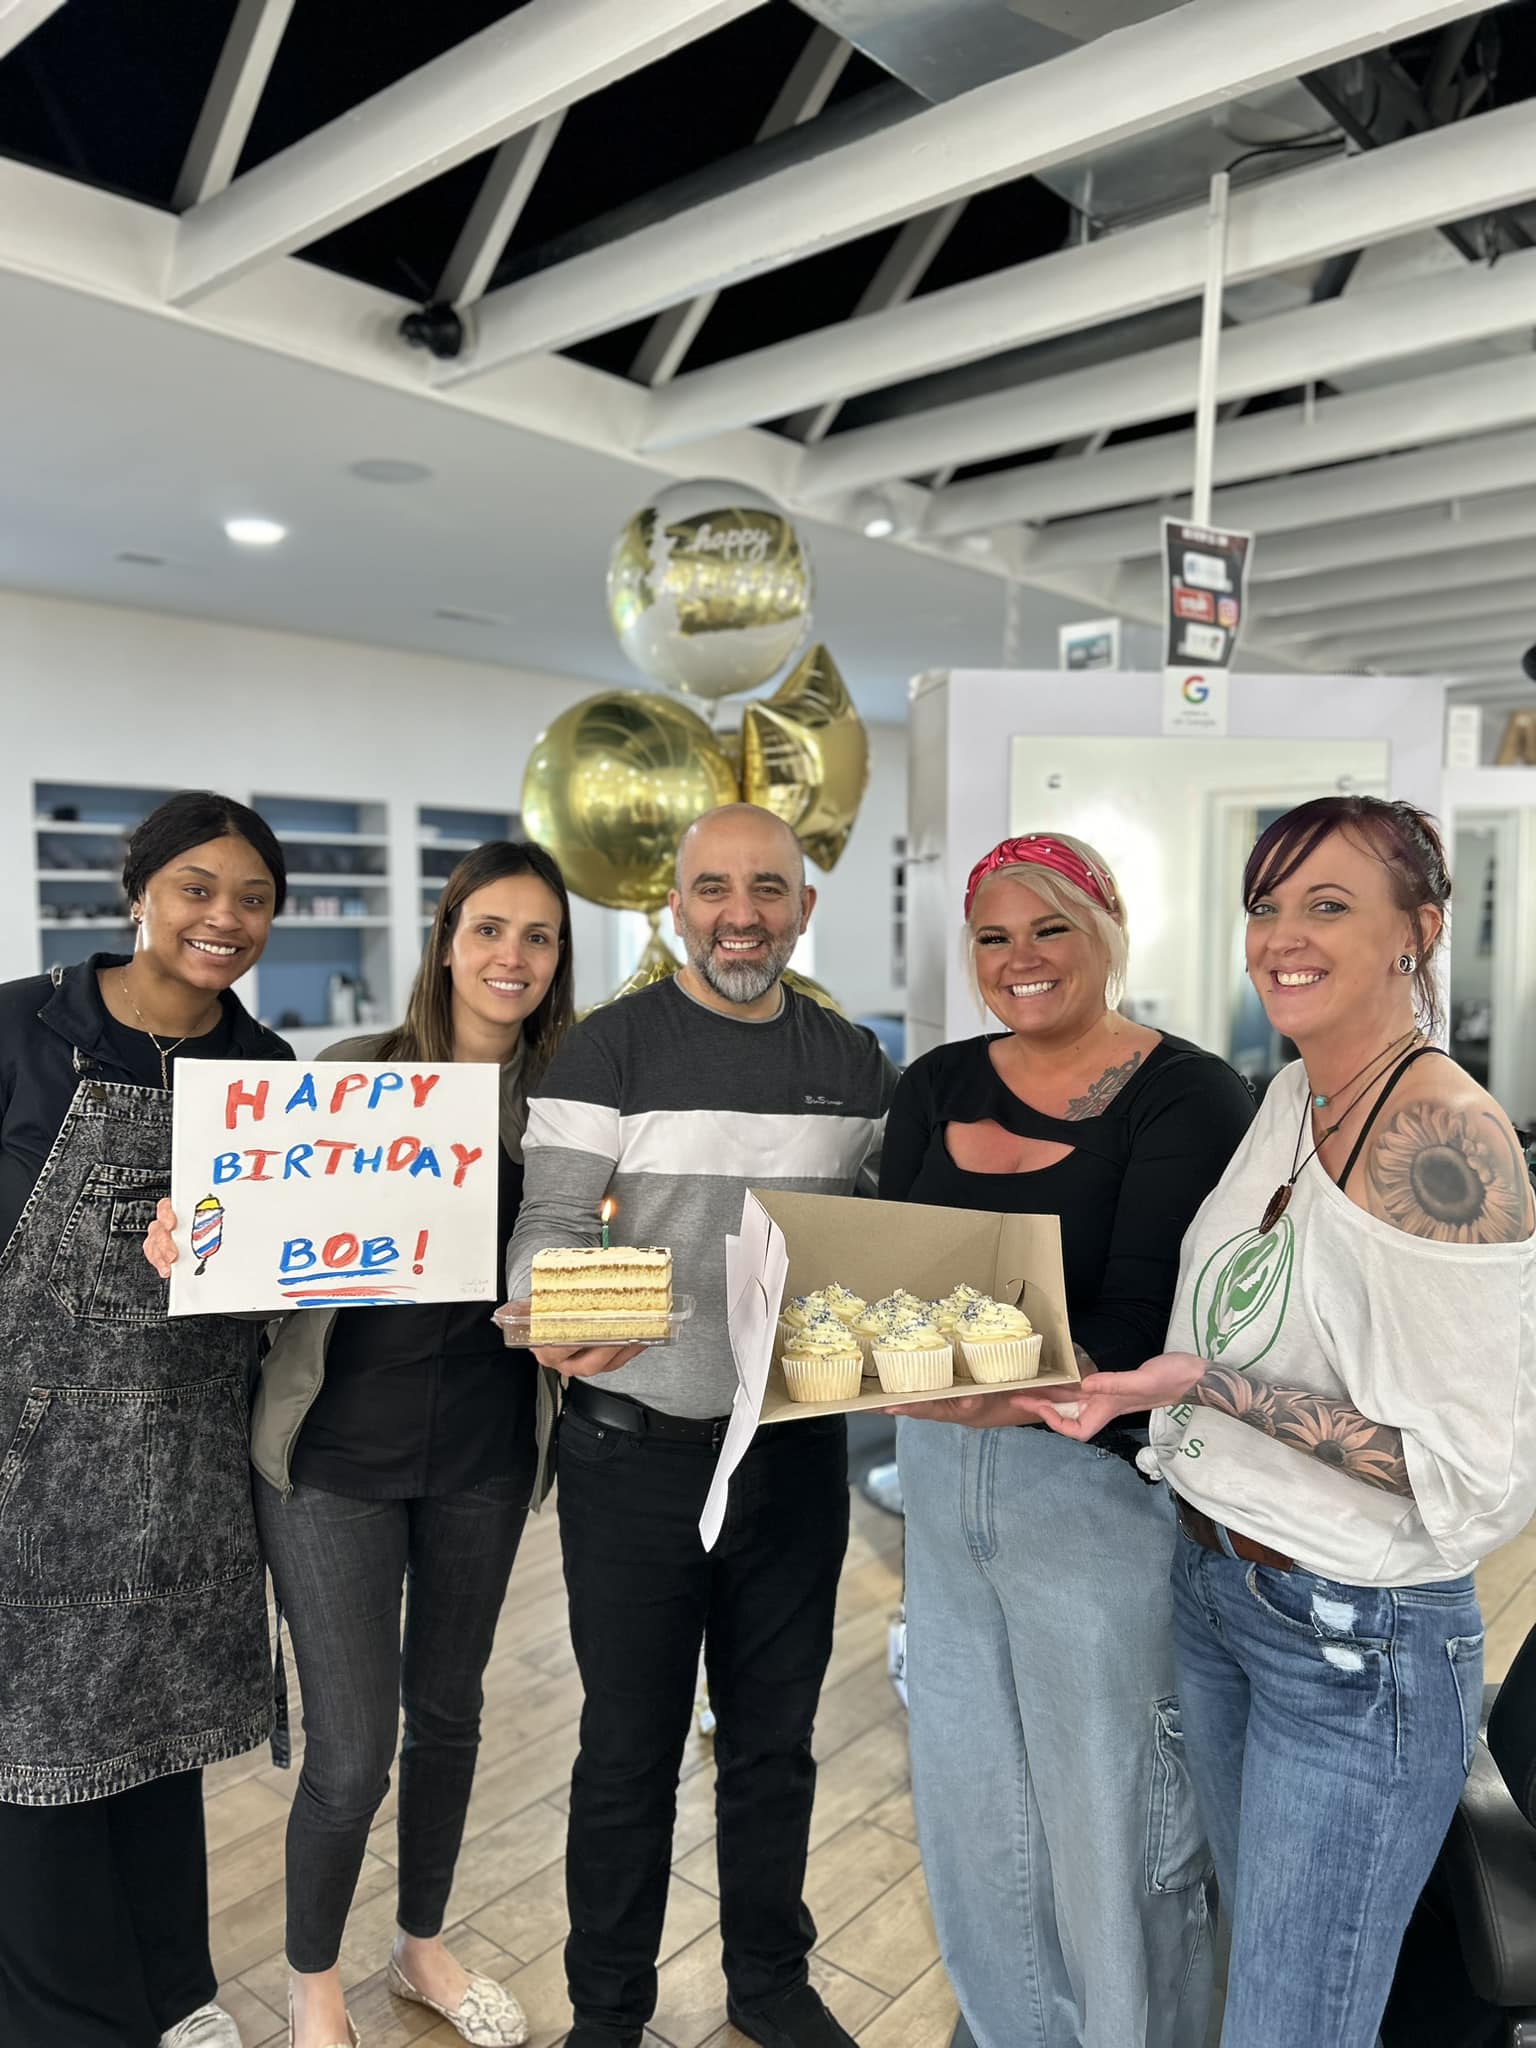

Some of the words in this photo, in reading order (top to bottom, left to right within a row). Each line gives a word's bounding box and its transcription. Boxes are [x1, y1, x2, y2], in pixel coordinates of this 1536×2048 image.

[685, 523, 771, 565] happy
[1182, 674, 1209, 705] G
[225, 1072, 440, 1129] HAPPY
[213, 1136, 482, 1188] BIRTHDAY
[279, 1230, 428, 1275] BOB!
